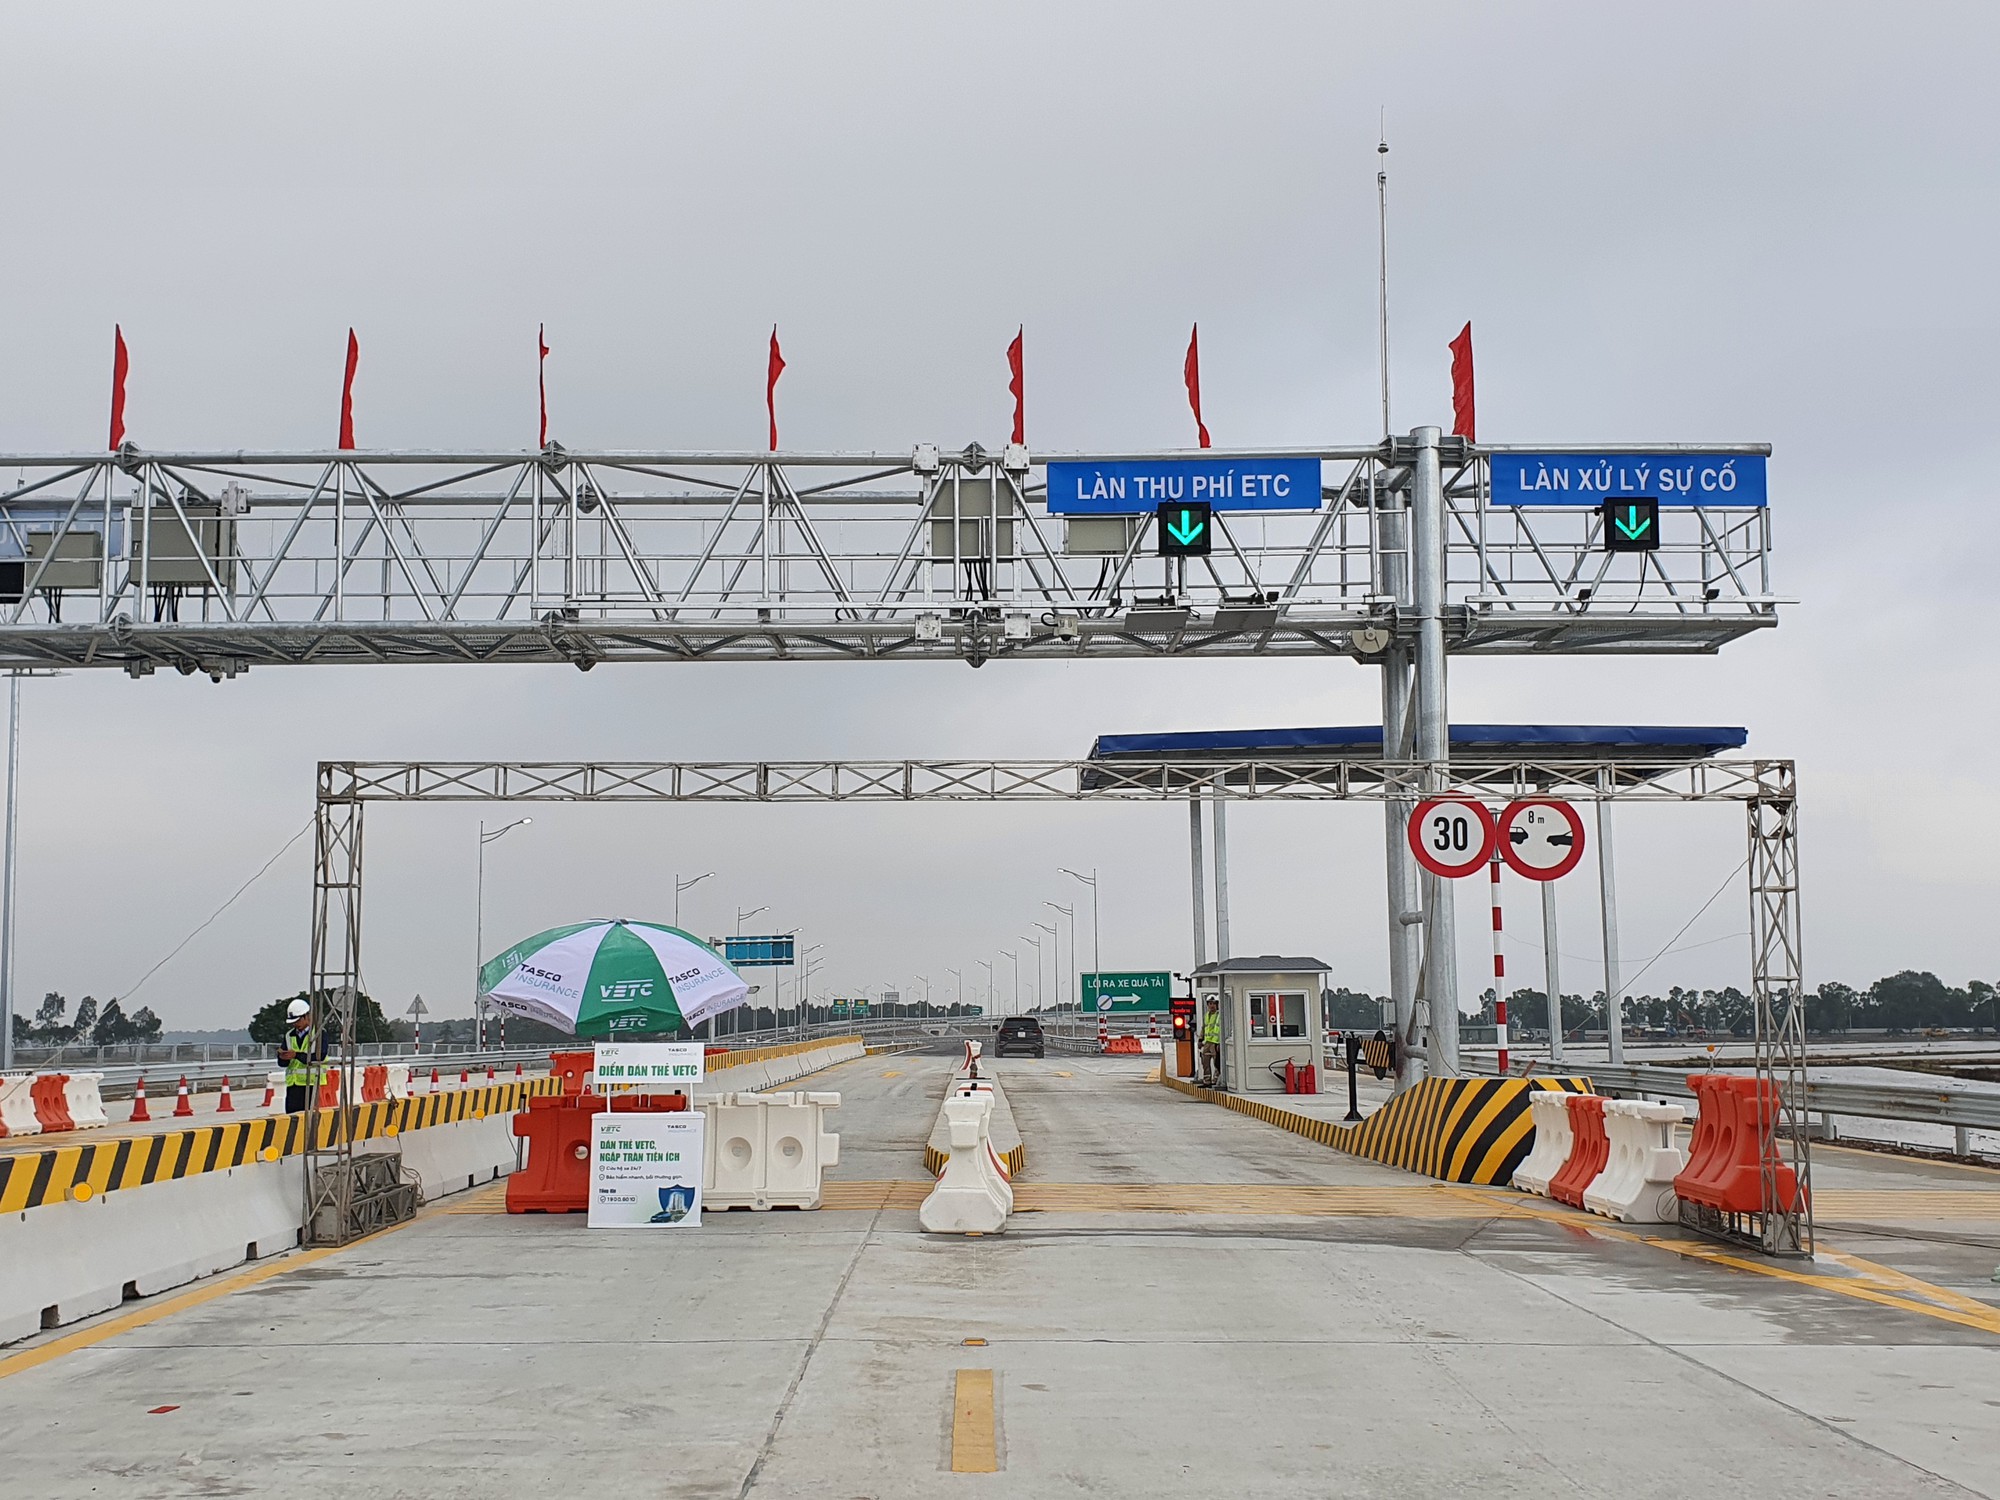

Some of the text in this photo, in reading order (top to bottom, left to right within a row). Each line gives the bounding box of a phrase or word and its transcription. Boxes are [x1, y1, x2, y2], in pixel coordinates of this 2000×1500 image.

[1077, 469, 1290, 499] LÀN THU PHÍ ETC
[1520, 459, 1737, 495] LÀN XỬ LÝ SỰ CỐ
[1528, 810, 1535, 823] 8
[1433, 817, 1468, 851] 30
[520, 963, 562, 982] TASCO
[668, 968, 701, 985] TASCO
[675, 968, 726, 993] INSURANCE
[1103, 979, 1115, 988] RA
[1118, 979, 1129, 988] XE
[1131, 977, 1149, 987] QUÁ
[1151, 976, 1164, 987] TẢI
[515, 973, 580, 999] INSURANCE
[600, 981, 653, 1000] VETC
[609, 1016, 648, 1029] VETC
[598, 1061, 624, 1076] ĐIỂM
[672, 1065, 698, 1076] VETC
[635, 1140, 657, 1150] VETC,
